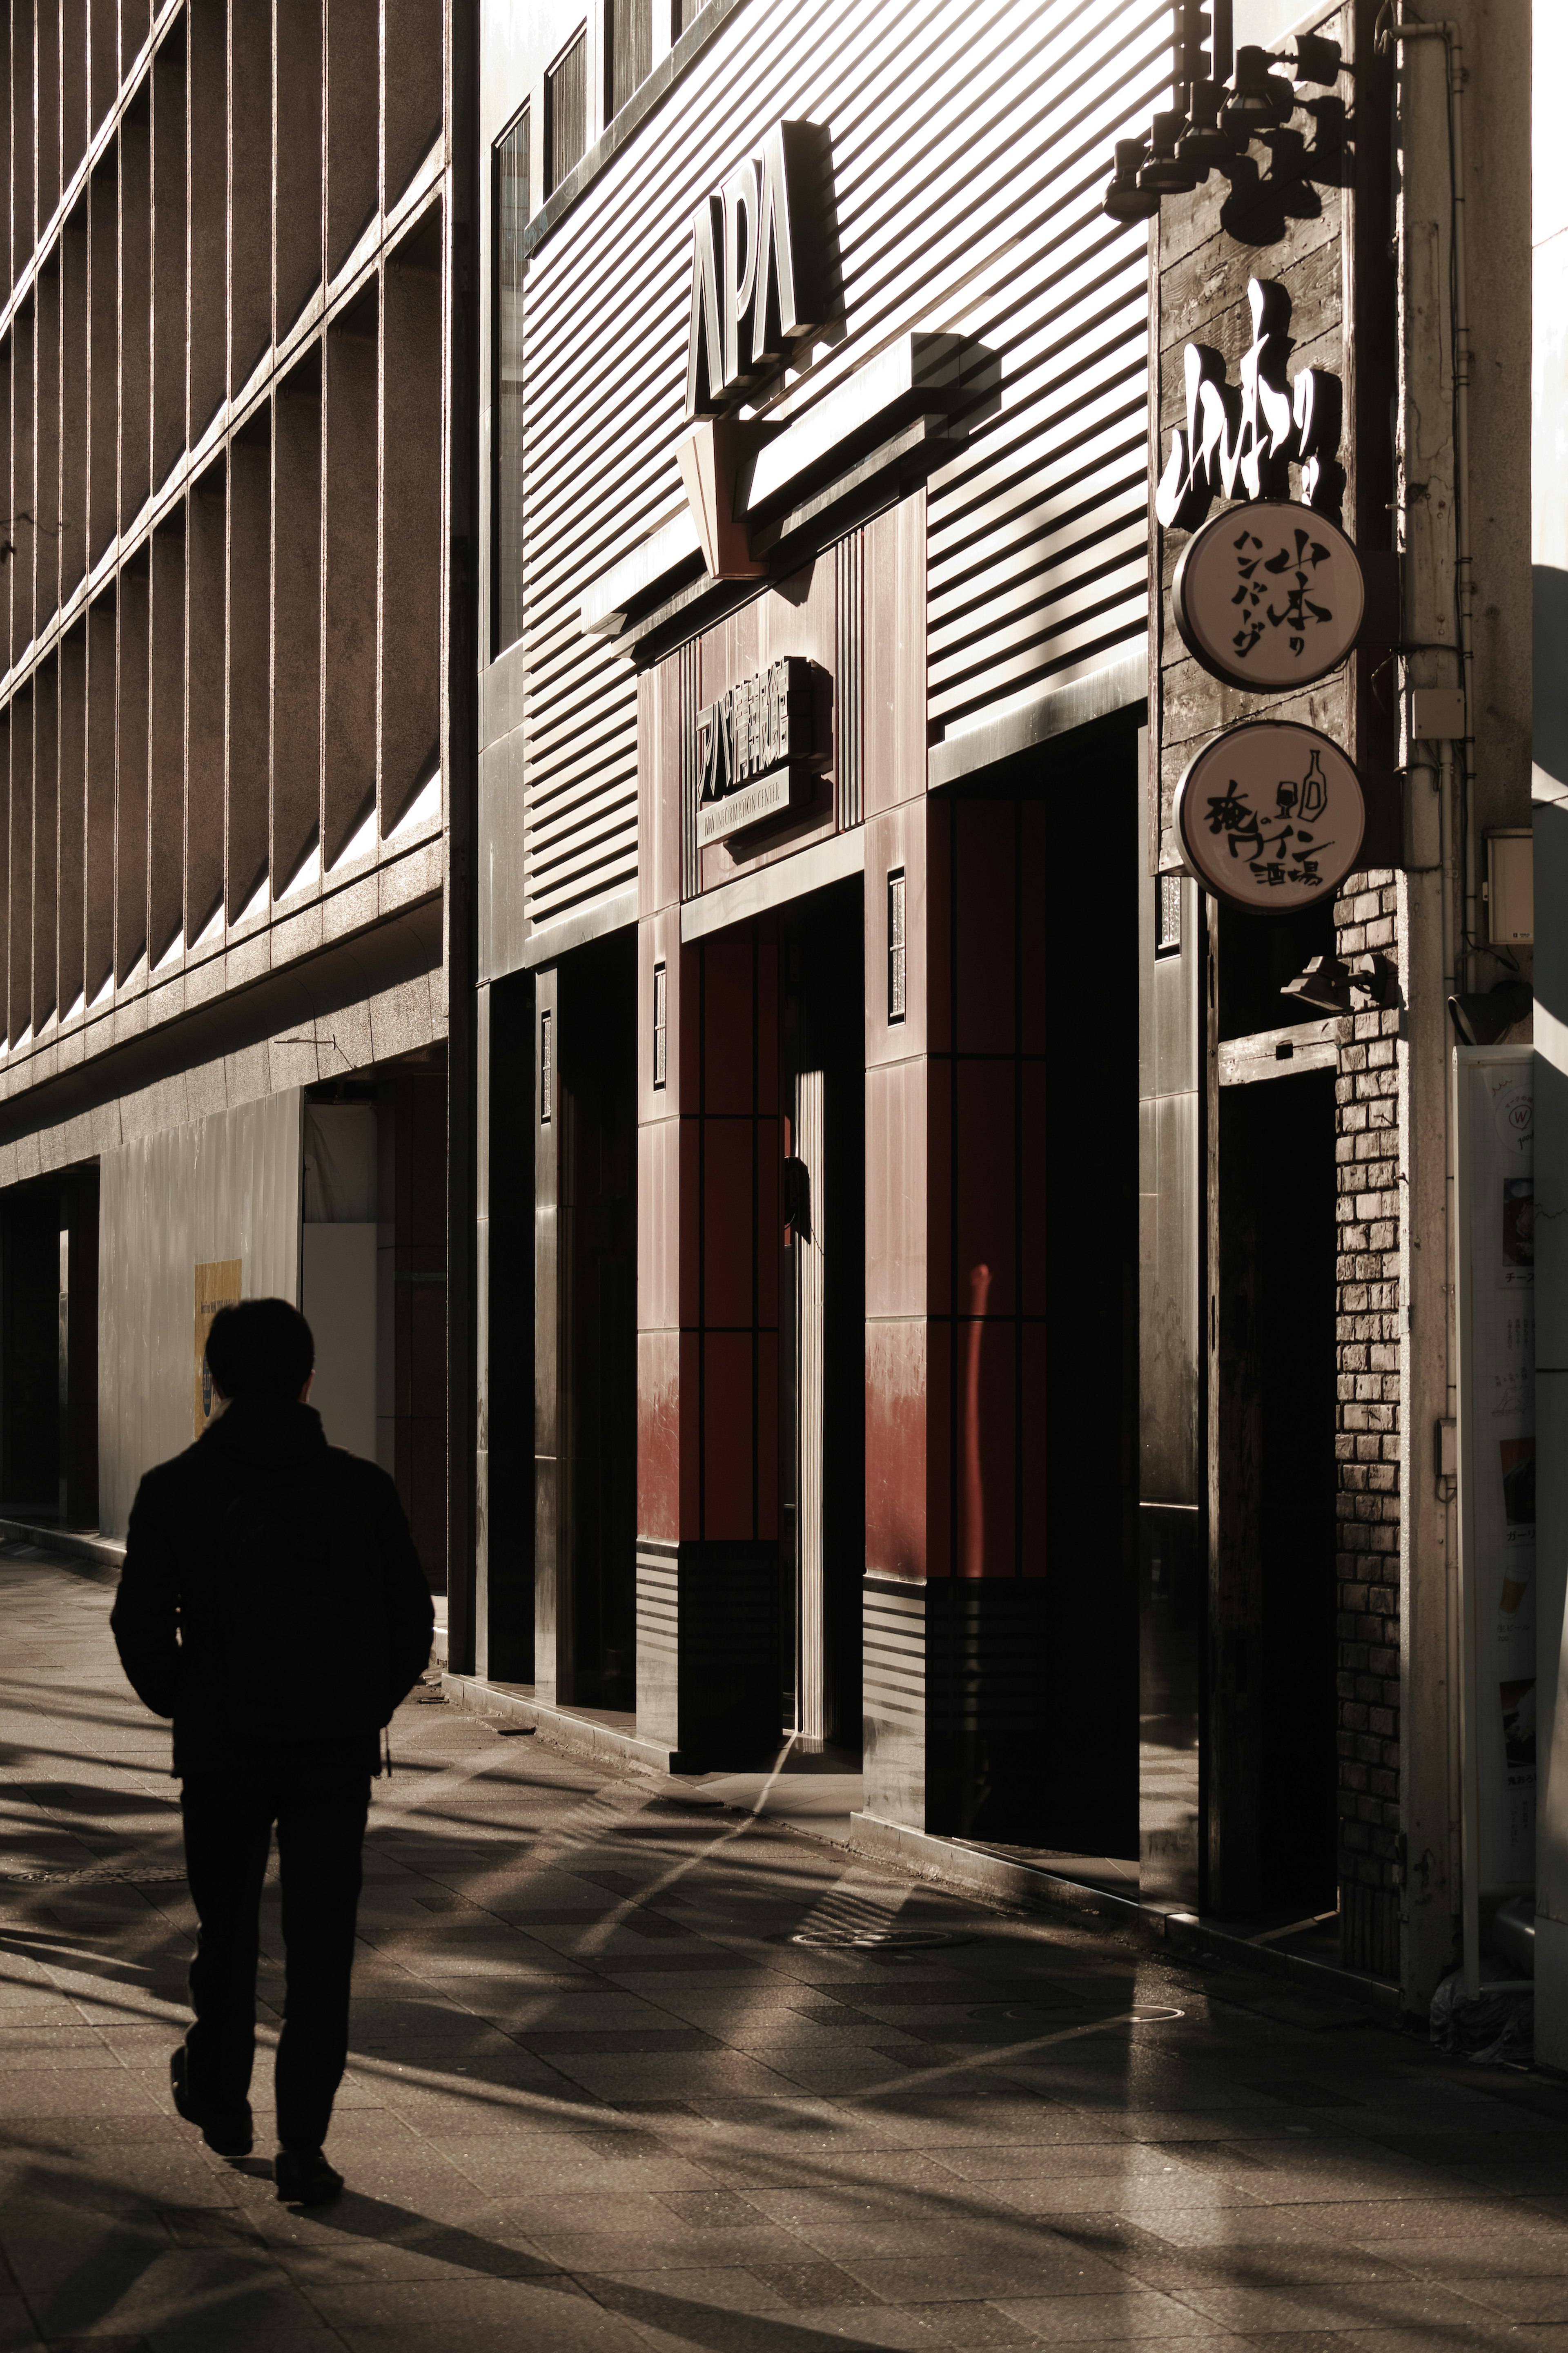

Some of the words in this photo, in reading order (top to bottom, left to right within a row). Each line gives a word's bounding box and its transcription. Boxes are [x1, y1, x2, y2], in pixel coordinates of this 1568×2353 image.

[684, 120, 796, 423] APA
[1231, 531, 1267, 658] ハンバーグ
[1264, 529, 1331, 657] 山本の
[696, 656, 789, 802] アパ情報館
[705, 814, 715, 837] APA
[716, 793, 756, 830] INFORMATION
[758, 782, 780, 810] CENTER
[1204, 779, 1272, 834] 俺の
[1227, 824, 1335, 862] ワイン
[1250, 861, 1323, 886] 酒場
[1497, 1624, 1530, 1633] 生ビール
